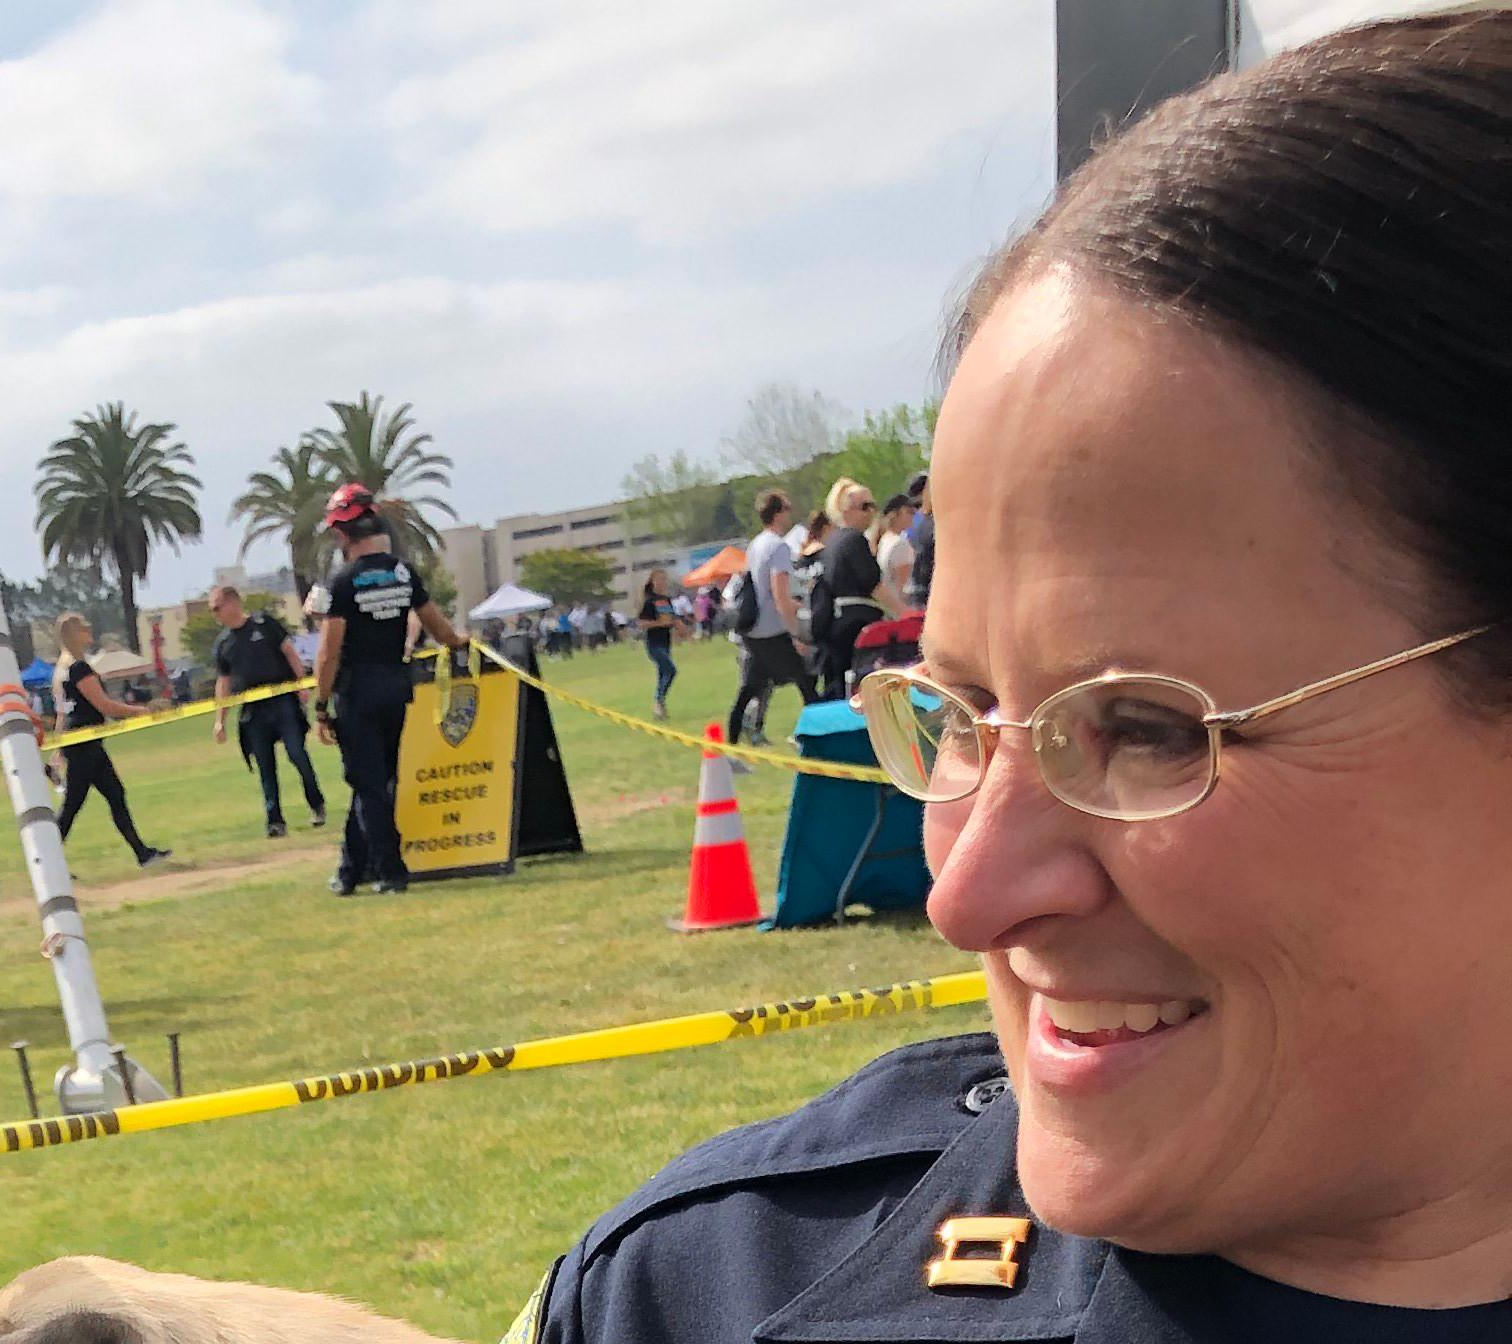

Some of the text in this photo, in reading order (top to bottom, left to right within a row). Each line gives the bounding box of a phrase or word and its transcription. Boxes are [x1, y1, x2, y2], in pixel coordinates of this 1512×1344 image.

[415, 760, 493, 782] CAUTION
[419, 785, 488, 805] RESCUE
[442, 811, 462, 825] IN
[404, 831, 497, 852] PROGRESS
